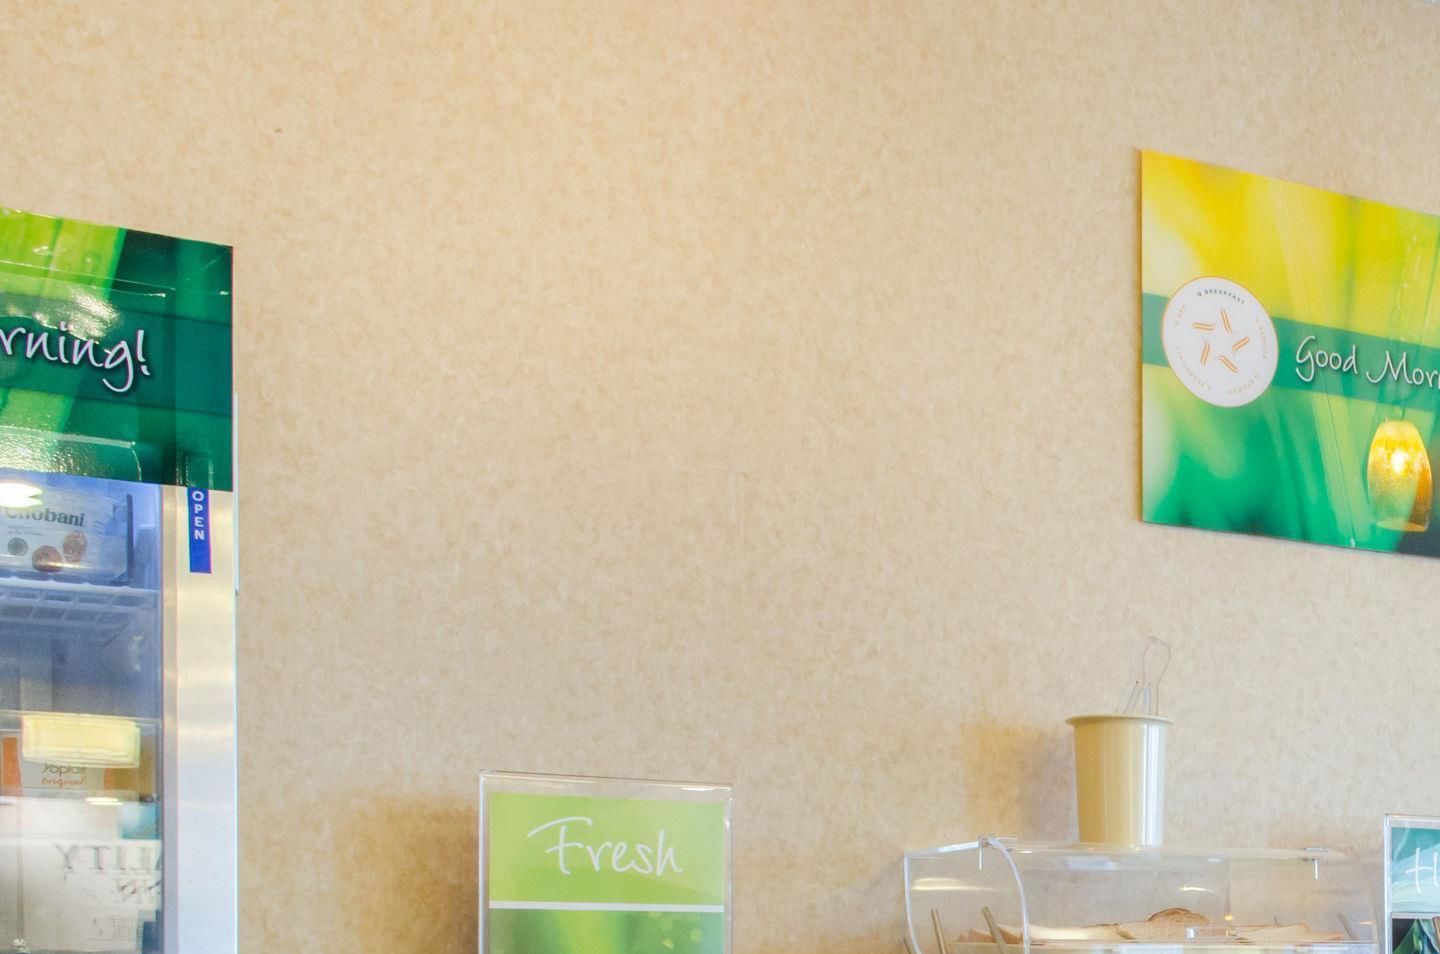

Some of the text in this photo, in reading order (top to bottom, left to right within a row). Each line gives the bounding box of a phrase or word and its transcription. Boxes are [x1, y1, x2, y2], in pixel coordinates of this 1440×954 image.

[1295, 335, 1359, 383] Good
[192, 490, 206, 541] OPEN
[527, 815, 684, 877] Fresh
